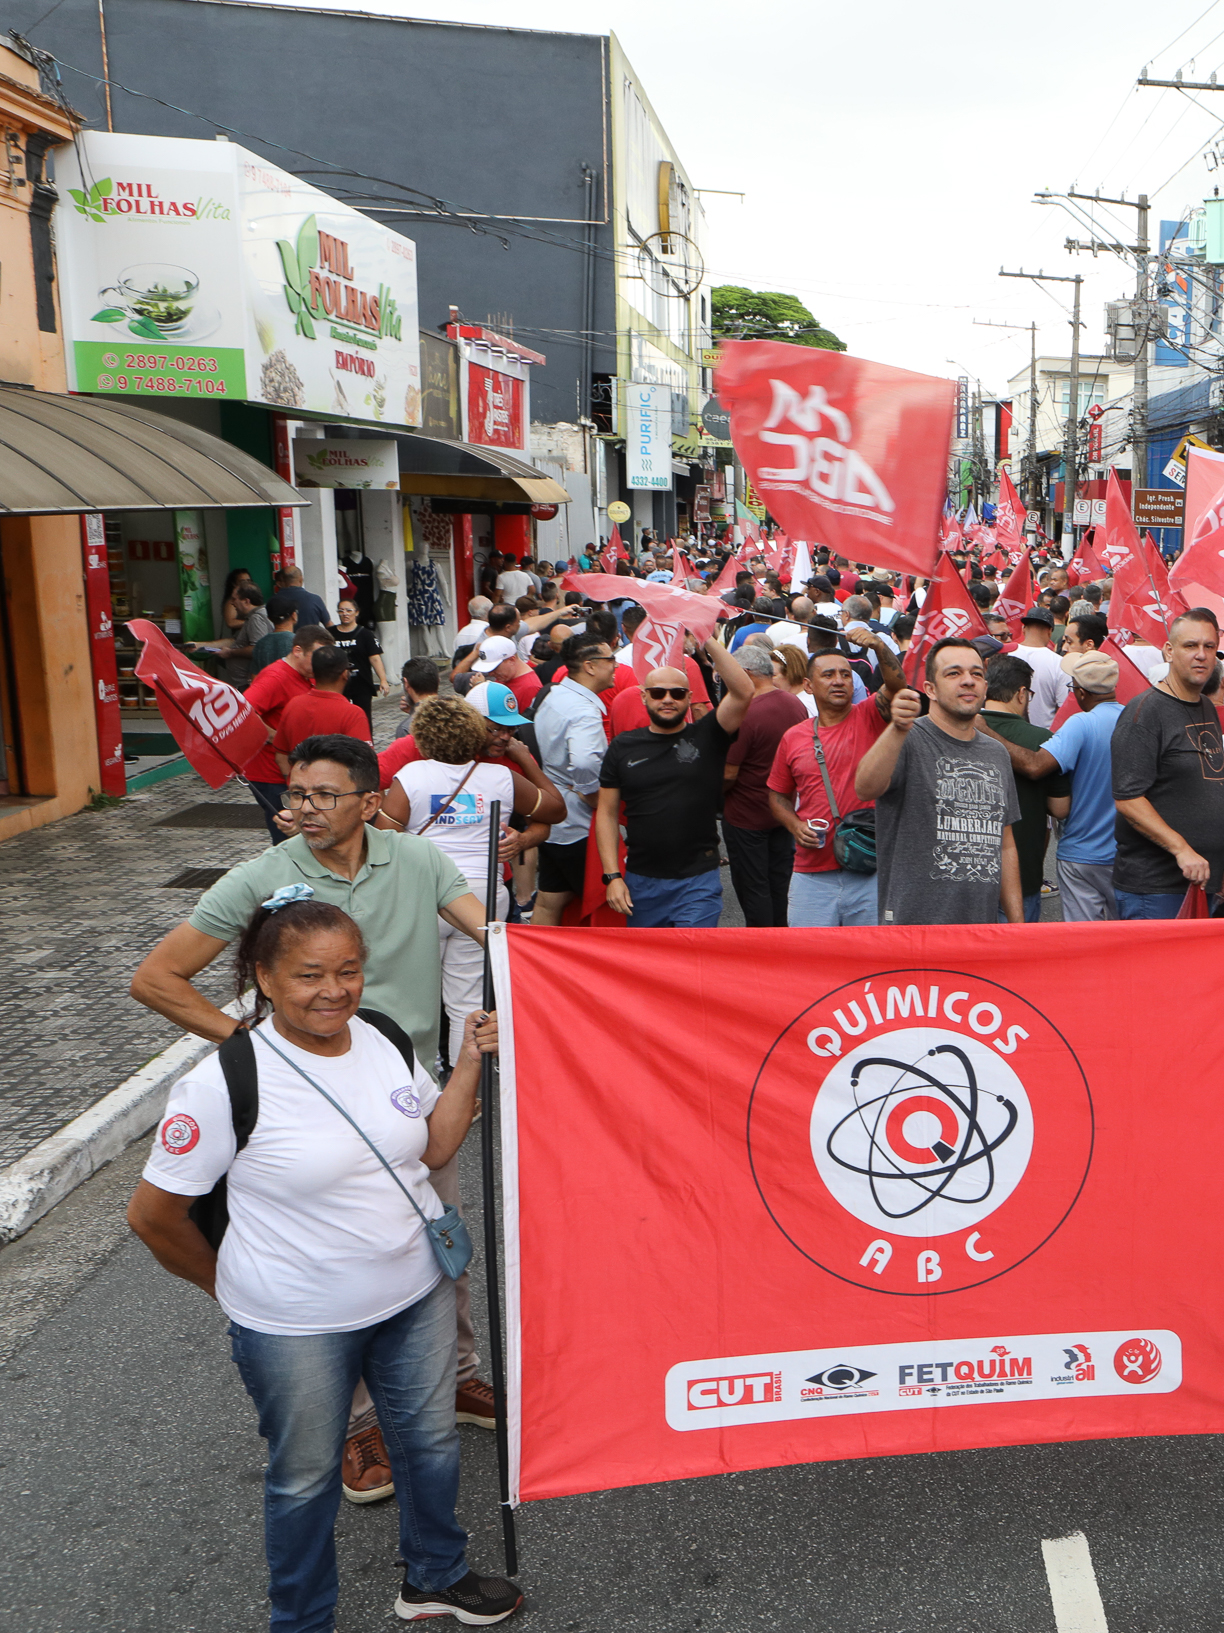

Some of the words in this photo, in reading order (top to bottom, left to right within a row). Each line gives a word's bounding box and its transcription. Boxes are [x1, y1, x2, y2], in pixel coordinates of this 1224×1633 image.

[115, 182, 159, 198] MIL
[102, 197, 196, 217] FOLHAS
[195, 197, 231, 220] Vita
[318, 230, 354, 281] MIL
[308, 267, 381, 331] FOLHAS
[379, 283, 402, 341] Vita
[125, 354, 218, 373] 2897-0263
[334, 350, 376, 378] EMPÓRIO
[117, 375, 128, 390] 9
[133, 376, 227, 395] 7488-7104
[640, 392, 652, 456] PURIFIC
[322, 458, 368, 467] FOLHAS
[329, 450, 350, 459] MIL
[631, 475, 668, 488] 4332-4400
[807, 982, 1030, 1057] QUÍMICOS
[688, 1375, 771, 1408] CUT
[774, 1370, 782, 1402] BRASIL
[800, 1387, 823, 1396] CNQ
